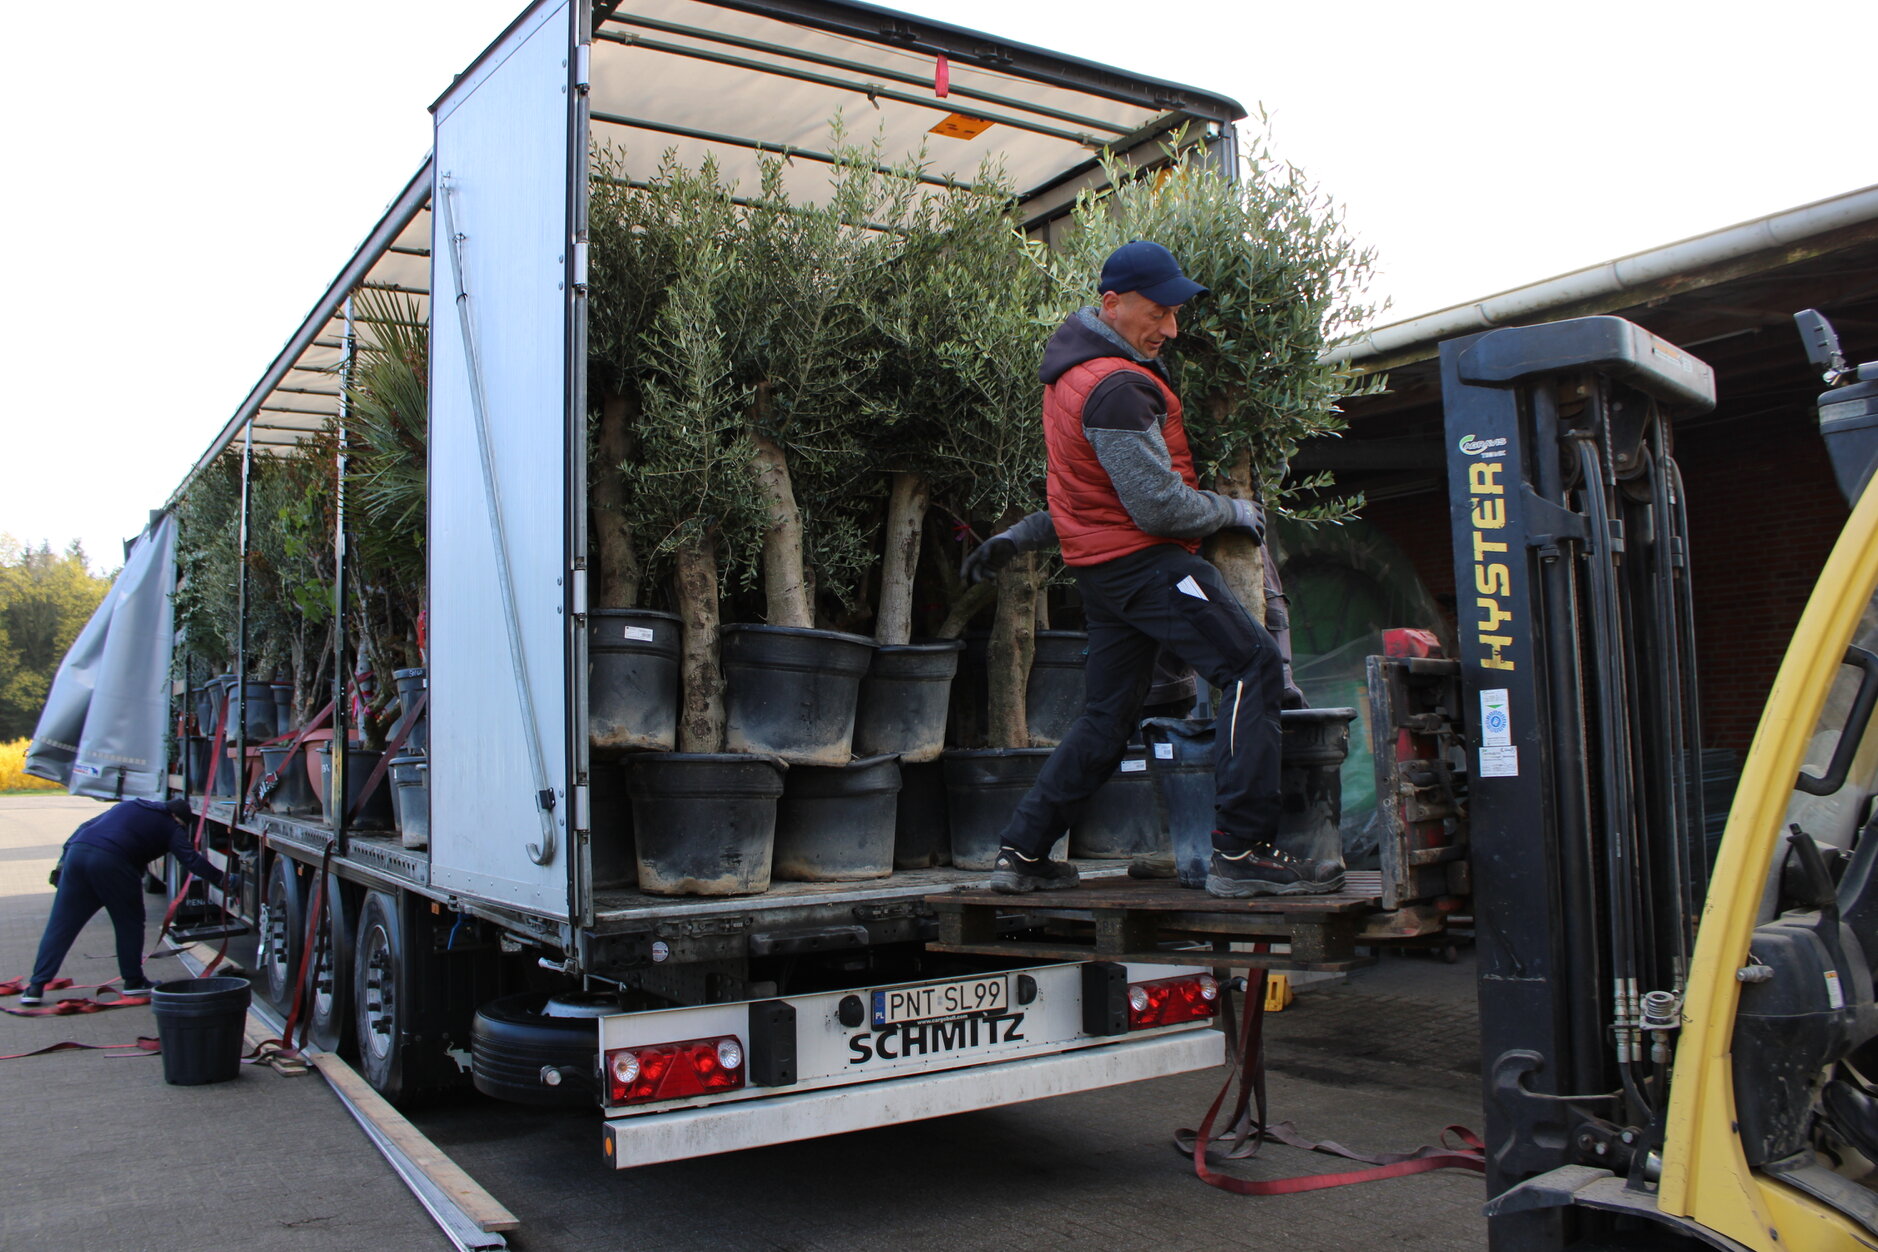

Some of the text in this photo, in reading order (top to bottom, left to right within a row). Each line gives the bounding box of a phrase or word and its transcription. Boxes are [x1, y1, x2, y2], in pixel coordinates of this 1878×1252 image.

[1469, 462, 1515, 670] HYSTER
[875, 1011, 885, 1020] PL
[891, 981, 1000, 1020] PNT SL99
[849, 1012, 1024, 1064] SCHMITZ
